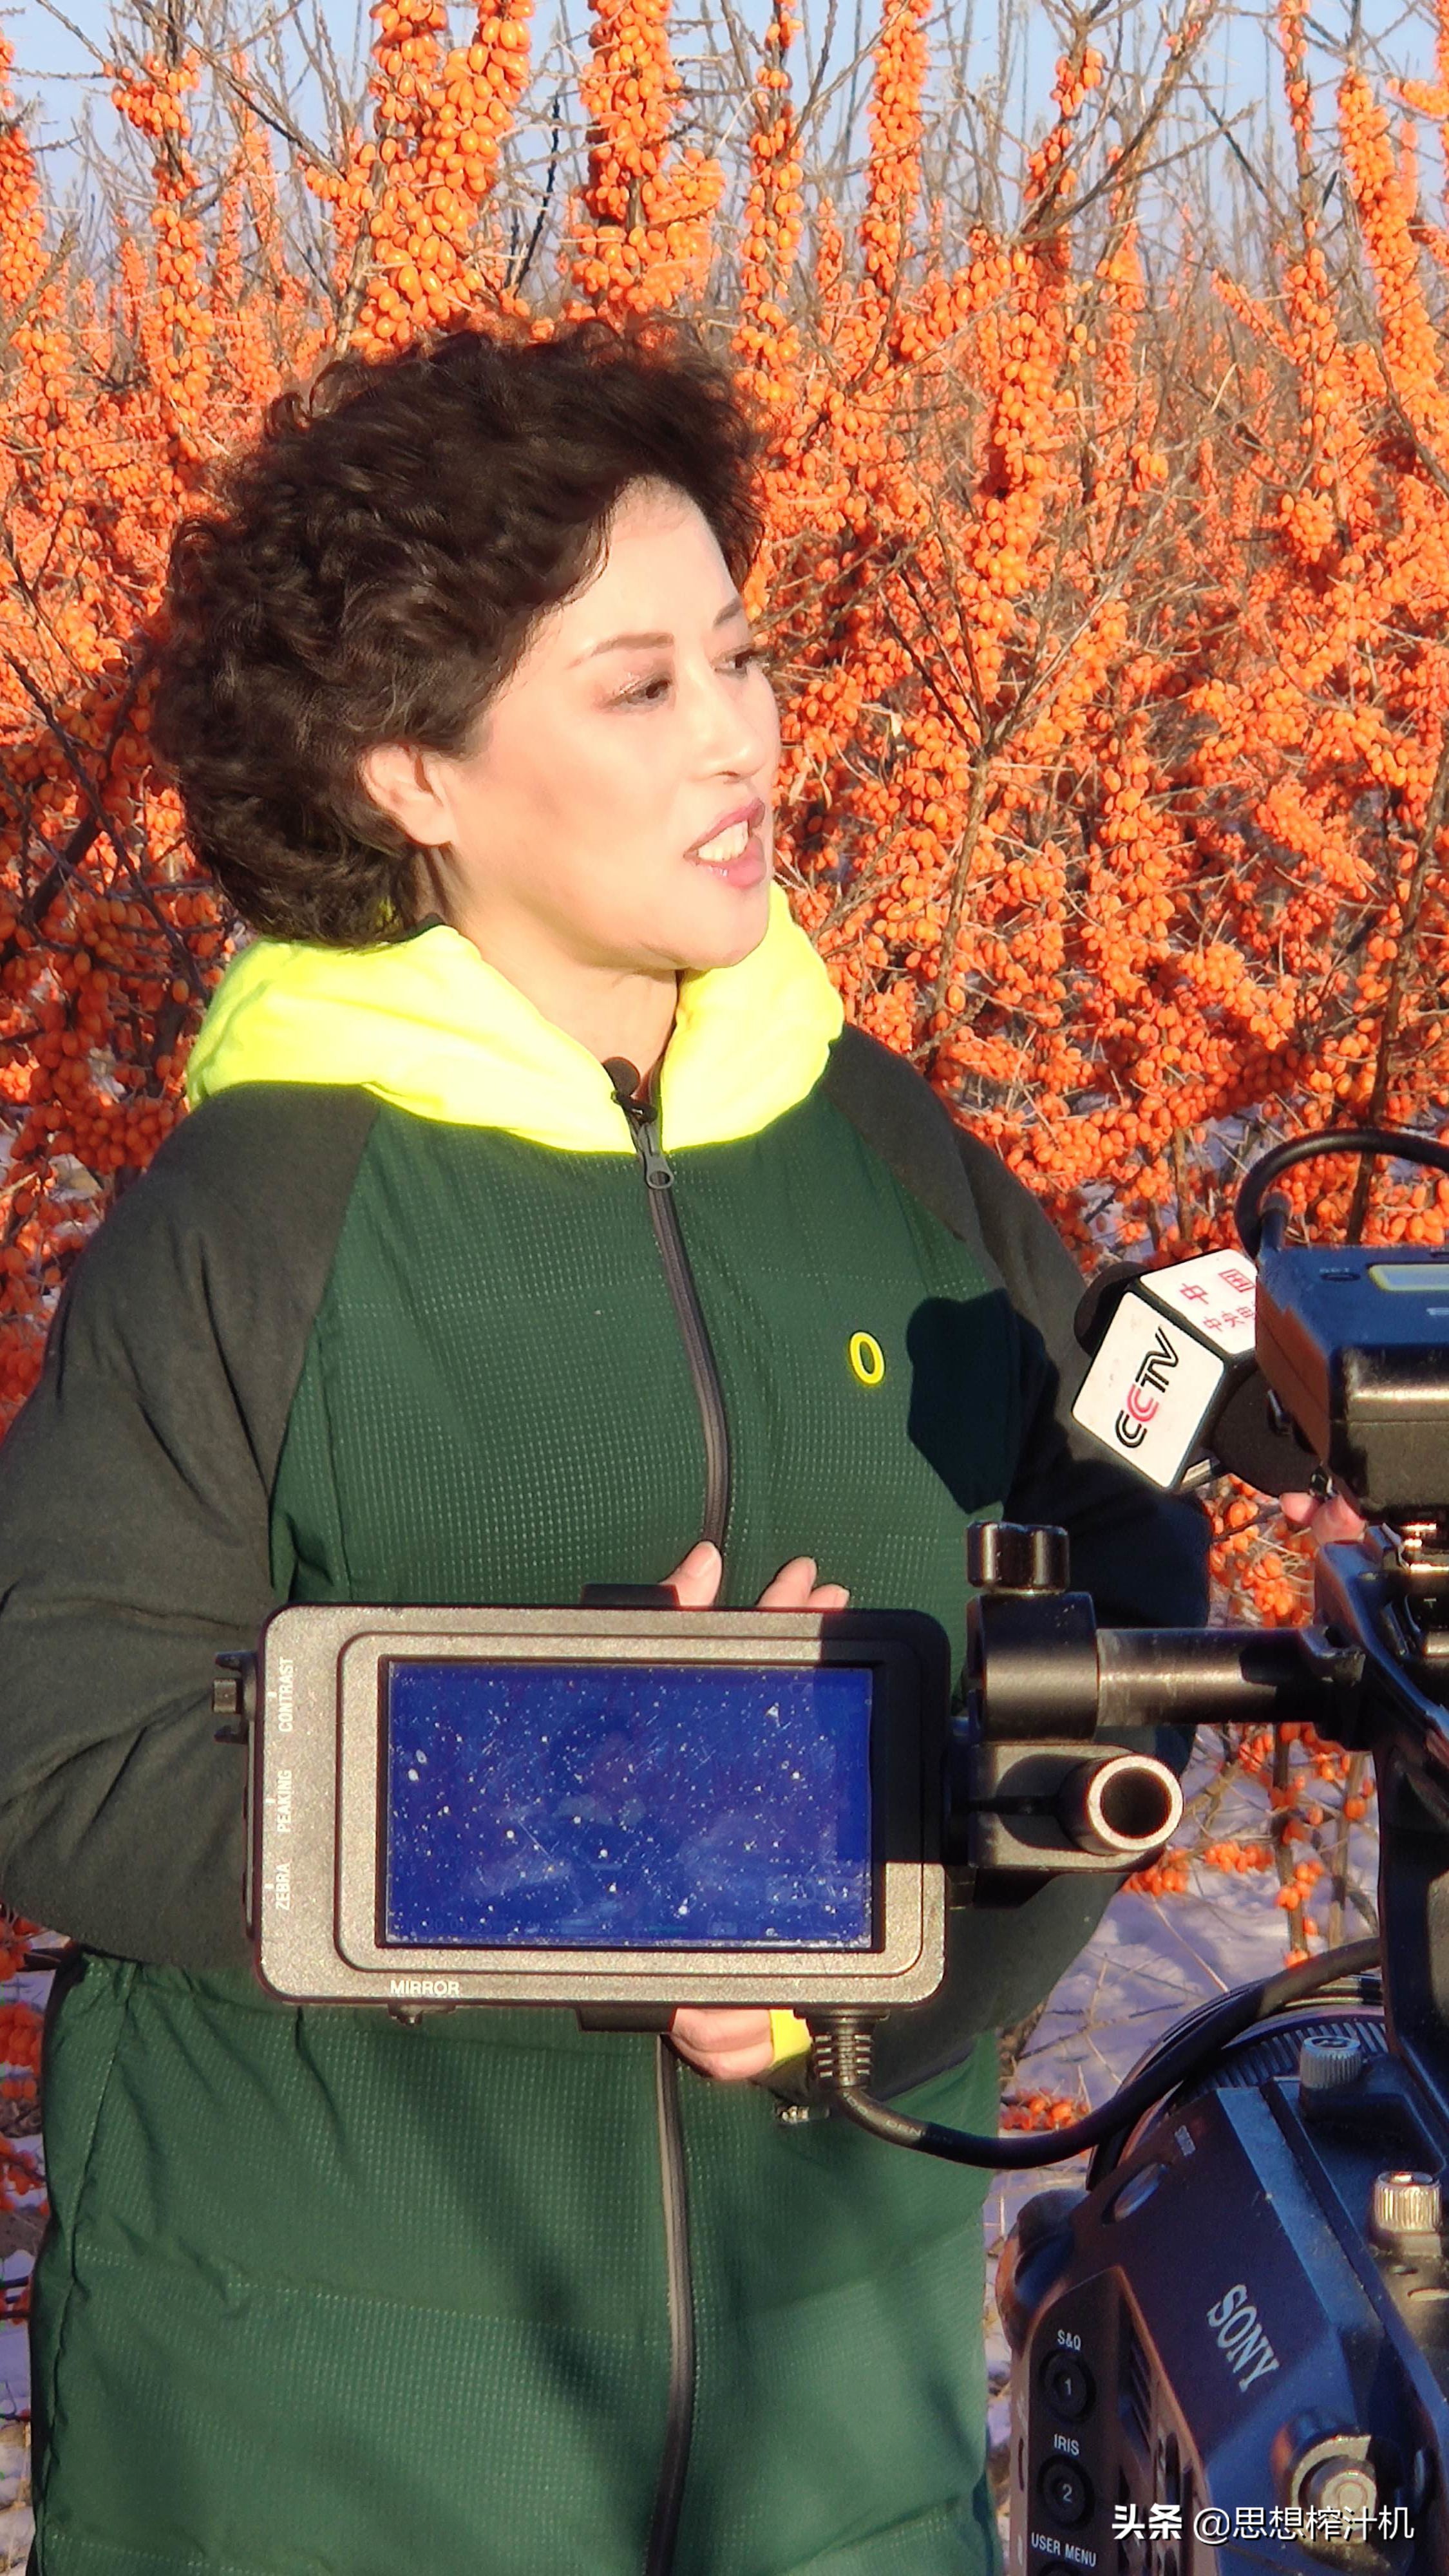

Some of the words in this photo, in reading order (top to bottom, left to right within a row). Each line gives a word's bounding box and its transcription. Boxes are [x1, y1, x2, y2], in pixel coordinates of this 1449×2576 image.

[1179, 1269, 1255, 1304] 中国
[1203, 1302, 1255, 1332] 中央电
[1115, 1326, 1179, 1448] CCTV
[278, 1656, 293, 1732] CONTRAST
[277, 1770, 292, 1832] PEAKING
[276, 1862, 290, 1911] ZEBRA
[390, 1980, 460, 1996] MIRROR
[1057, 2329, 1081, 2351] S&Q
[1207, 2284, 1280, 2392] SONY
[1064, 2378, 1072, 2396] 1
[1054, 2433, 1080, 2456] IRIS
[1063, 2483, 1072, 2503] 2
[1031, 2532, 1061, 2556] USER
[1065, 2543, 1097, 2568] MENU
